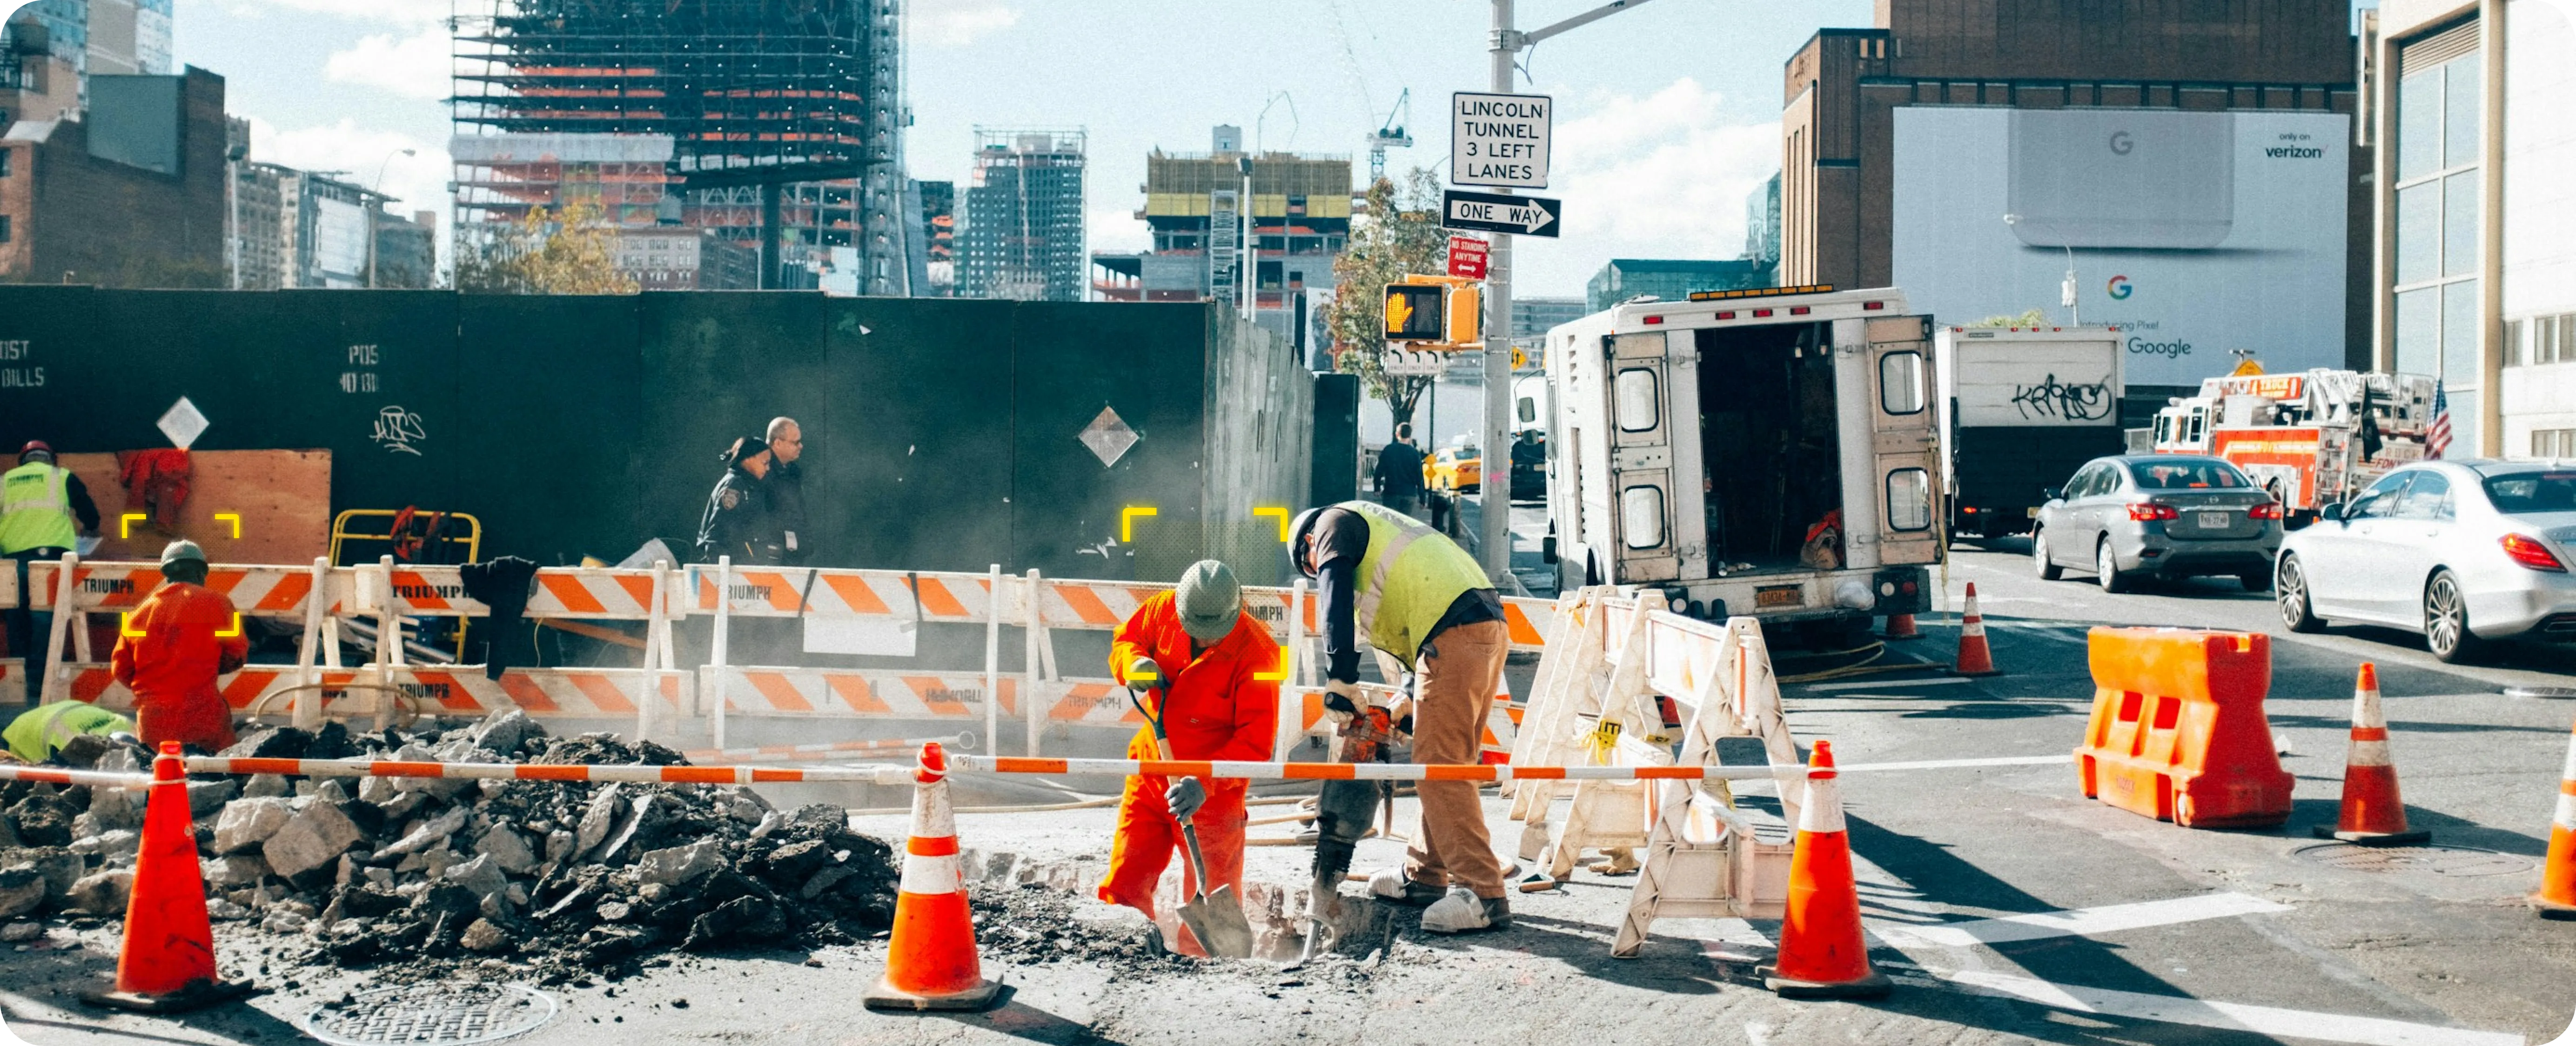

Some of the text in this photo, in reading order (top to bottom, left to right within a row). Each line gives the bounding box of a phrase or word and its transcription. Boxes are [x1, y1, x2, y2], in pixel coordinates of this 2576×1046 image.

[1462, 101, 1542, 119] LINCOLN
[1464, 122, 1539, 139] TUNNEL
[2279, 133, 2297, 141] only
[1466, 142, 1535, 159] 3 LEFT
[2109, 131, 2134, 156] G
[2265, 145, 2322, 159] verizon
[1469, 163, 1532, 180] LANES
[1460, 203, 1543, 224] ONE WAY
[1451, 241, 1486, 252] NO STANDING
[1455, 252, 1481, 263] ANYTIME
[2107, 275, 2133, 300] G
[2137, 320, 2159, 330] Pixel
[2128, 337, 2191, 359] Google
[83, 578, 134, 593] TRIUMPH
[717, 584, 772, 600] RIUMPH
[398, 683, 450, 698] TRIUMPH
